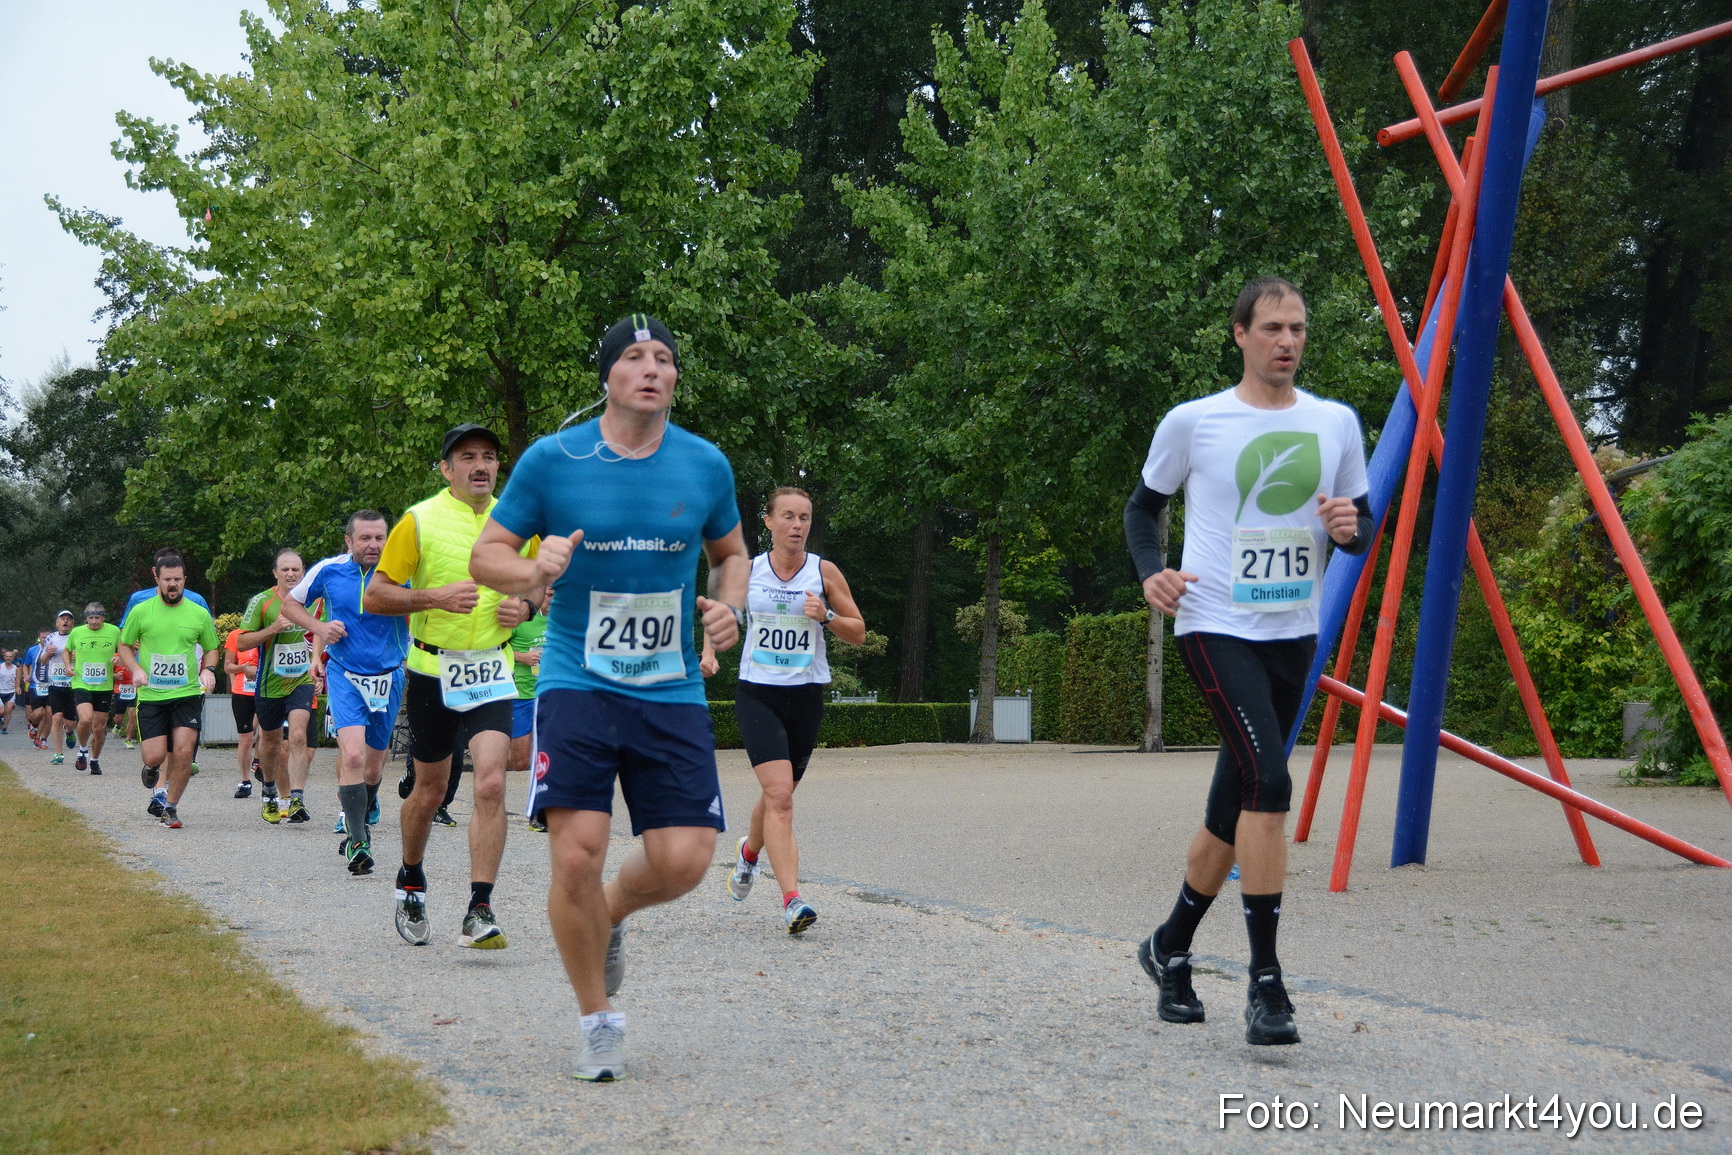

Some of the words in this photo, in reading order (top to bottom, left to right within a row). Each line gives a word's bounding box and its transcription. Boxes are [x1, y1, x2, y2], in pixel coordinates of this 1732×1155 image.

[583, 536, 687, 553] www.hasit.de
[1241, 546, 1310, 580] 2715
[1251, 586, 1300, 601] Christian
[598, 614, 675, 651] 2490
[758, 627, 810, 651] 2004
[278, 650, 307, 666] 2853
[775, 655, 789, 665] Eva
[85, 667, 106, 677] 3054
[153, 662, 185, 676] 2248
[448, 659, 506, 688] 2562
[612, 659, 660, 677] Stephan
[468, 688, 493, 701] Josef
